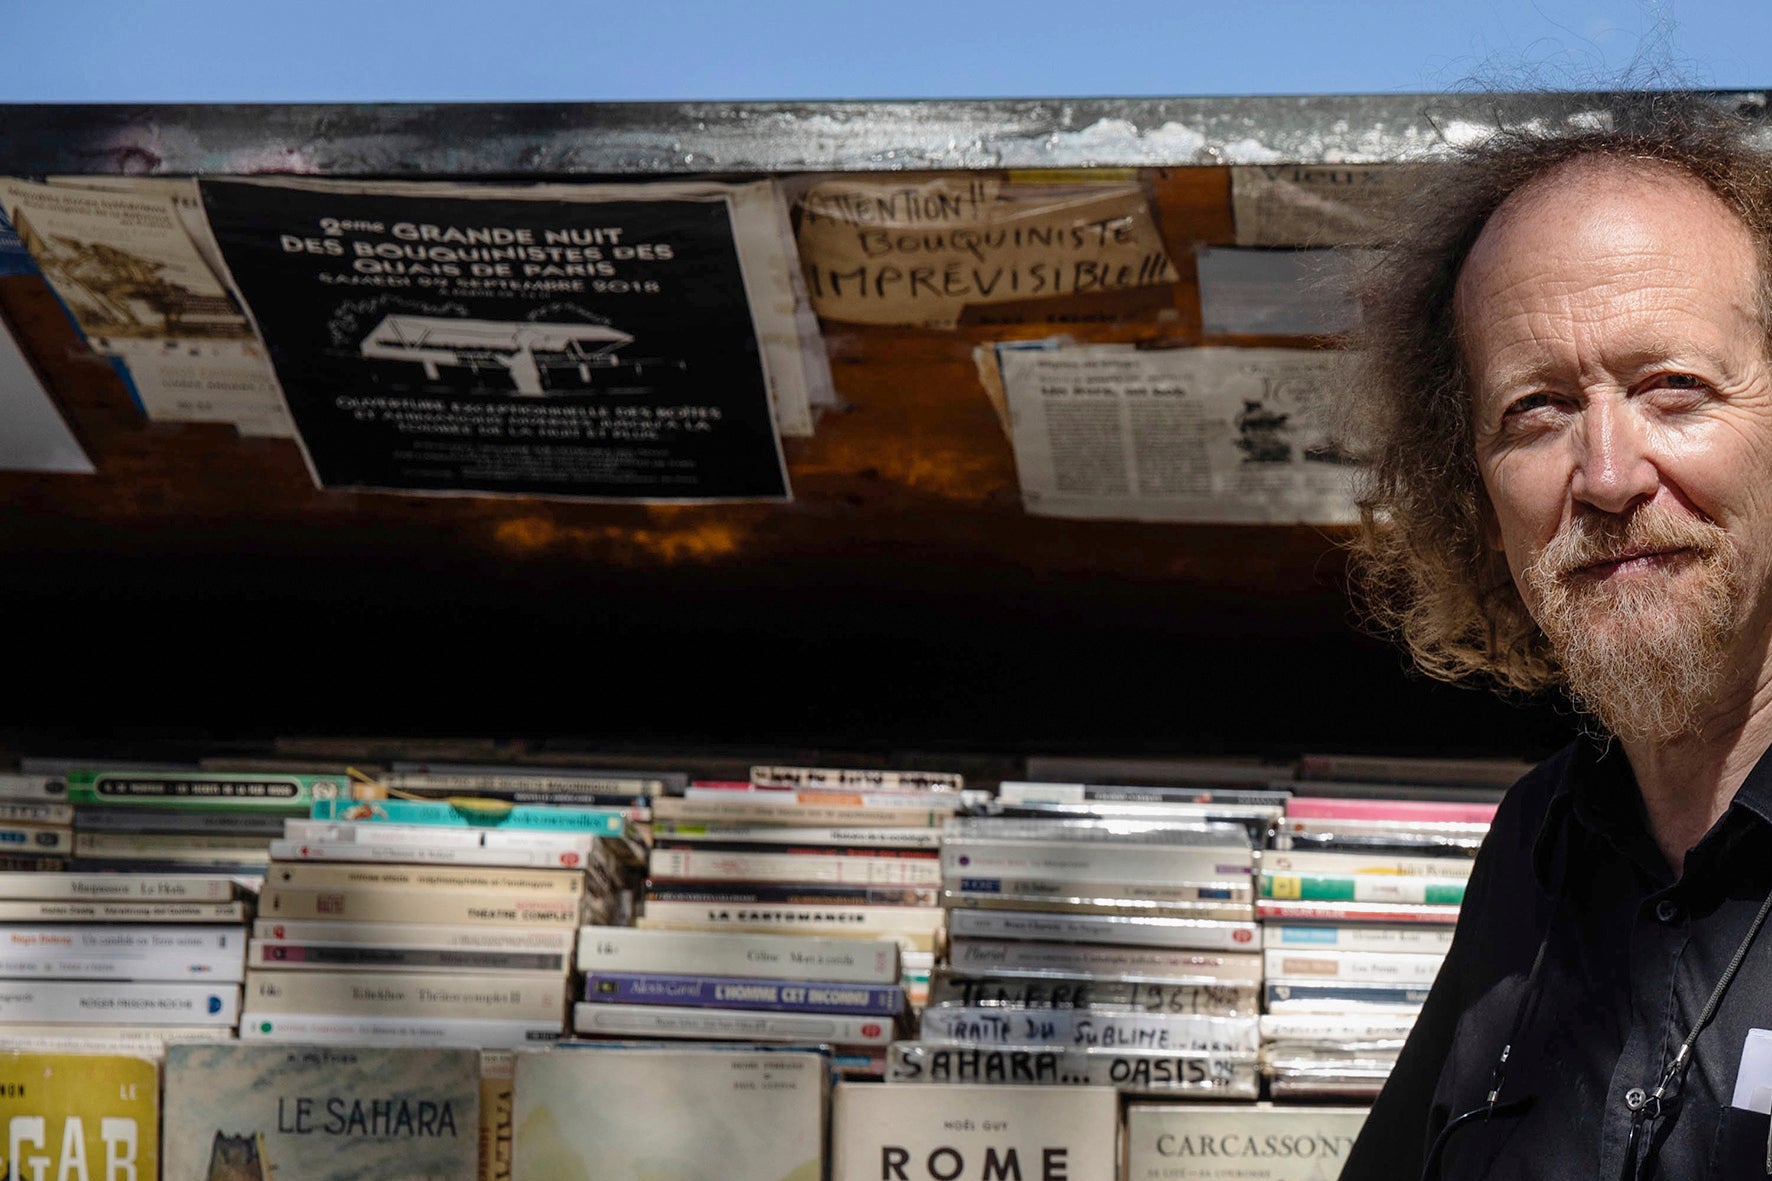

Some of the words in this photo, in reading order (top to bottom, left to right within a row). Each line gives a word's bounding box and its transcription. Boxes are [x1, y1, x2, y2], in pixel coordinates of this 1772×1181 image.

[391, 222, 535, 247] GRANDE
[544, 226, 624, 247] NUIT
[279, 234, 346, 257] DES
[353, 240, 602, 263] BOUQUINISTES
[613, 243, 675, 262] DES
[352, 257, 464, 277] QUAIS
[471, 261, 514, 278] DE
[523, 260, 618, 278] PARIS
[708, 910, 731, 922] LA
[740, 910, 866, 924] CARTOMANCIE
[714, 983, 778, 1004] L'HOMME
[780, 985, 806, 1004] CET
[808, 986, 871, 1006] INCONNU
[277, 1097, 314, 1135] LE
[323, 1098, 458, 1138] SAHARA
